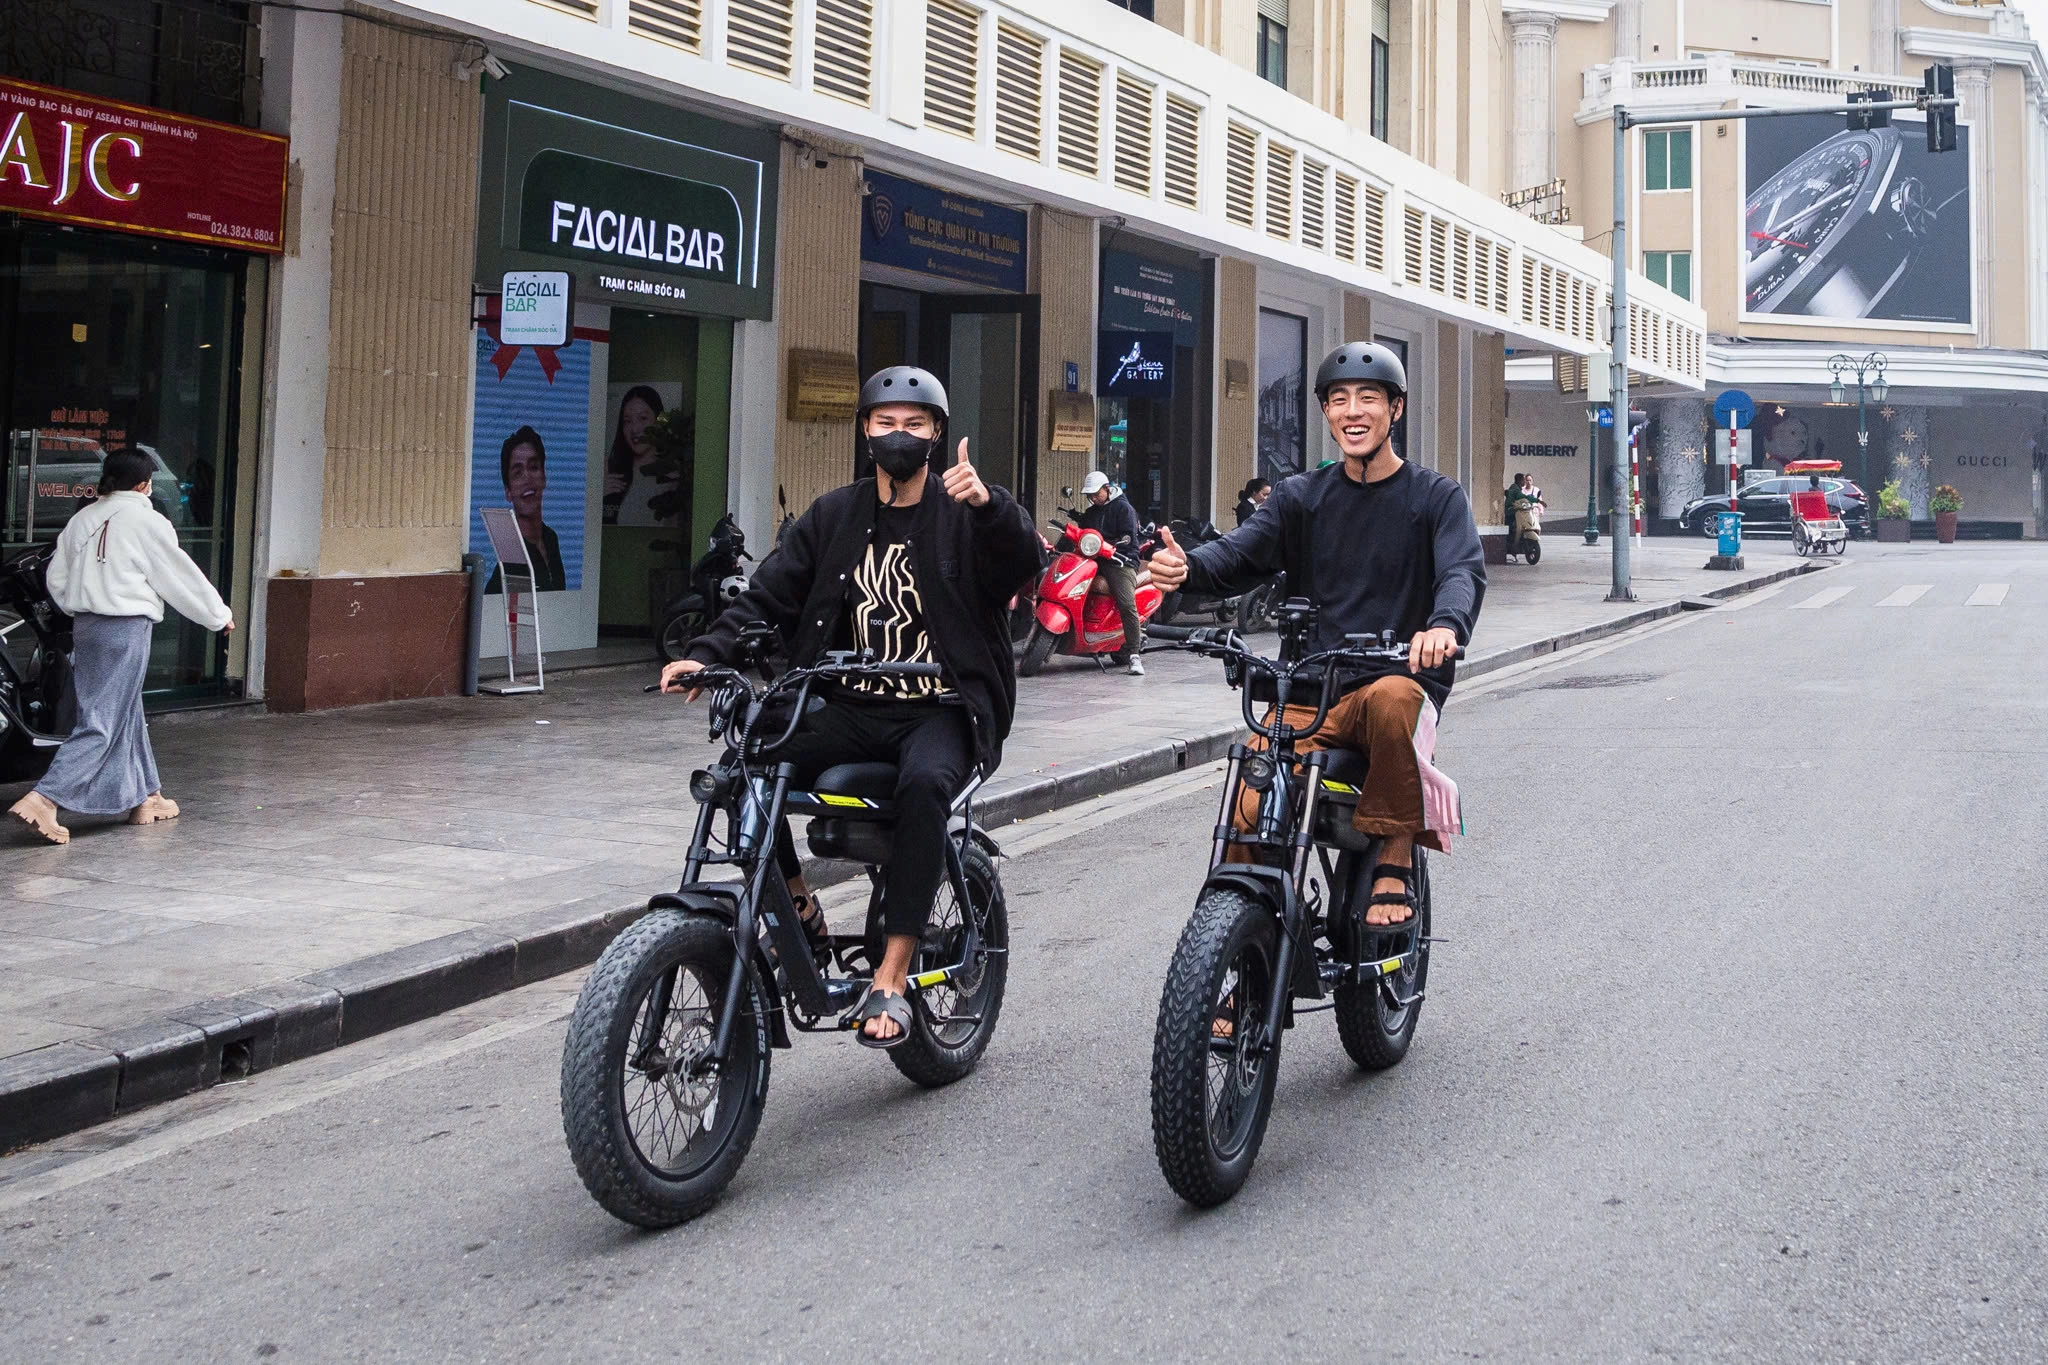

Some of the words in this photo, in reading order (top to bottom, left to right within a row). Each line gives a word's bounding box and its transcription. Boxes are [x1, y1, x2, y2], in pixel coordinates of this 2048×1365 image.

[10, 91, 36, 107] VÀNG
[39, 100, 58, 112] BẠC
[60, 102, 73, 115] ĐÁ
[76, 108, 94, 119] QUÝ
[95, 111, 122, 125] ASEAN
[124, 117, 139, 128] CHI
[141, 121, 169, 135] NHÁNH
[170, 126, 182, 137] HÀ
[183, 129, 198, 142] NỘI
[0, 111, 145, 206] AJC
[187, 211, 212, 221] HOTLINE
[211, 221, 274, 242] 024.3824.8804
[552, 200, 664, 261] FACIAL
[665, 223, 725, 272] BAR
[904, 208, 926, 231] TỔNG
[927, 218, 944, 238] CỤC
[945, 222, 967, 241] QUẢN
[967, 226, 977, 244] LÝ
[978, 231, 990, 250] THỊ
[992, 233, 1020, 254] TRƯỜNG
[506, 282, 561, 297] FACIAL
[600, 275, 625, 292] TRẠM
[627, 279, 653, 294] CHĂM
[654, 282, 673, 297] SÓC
[673, 287, 686, 300] DA
[1757, 274, 1785, 300] DUBAI
[505, 298, 537, 312] BAR
[1067, 370, 1076, 385] 91
[1510, 444, 1578, 457] BURBERRY
[1957, 455, 2007, 467] GUCCI
[38, 483, 99, 498] WELCO
